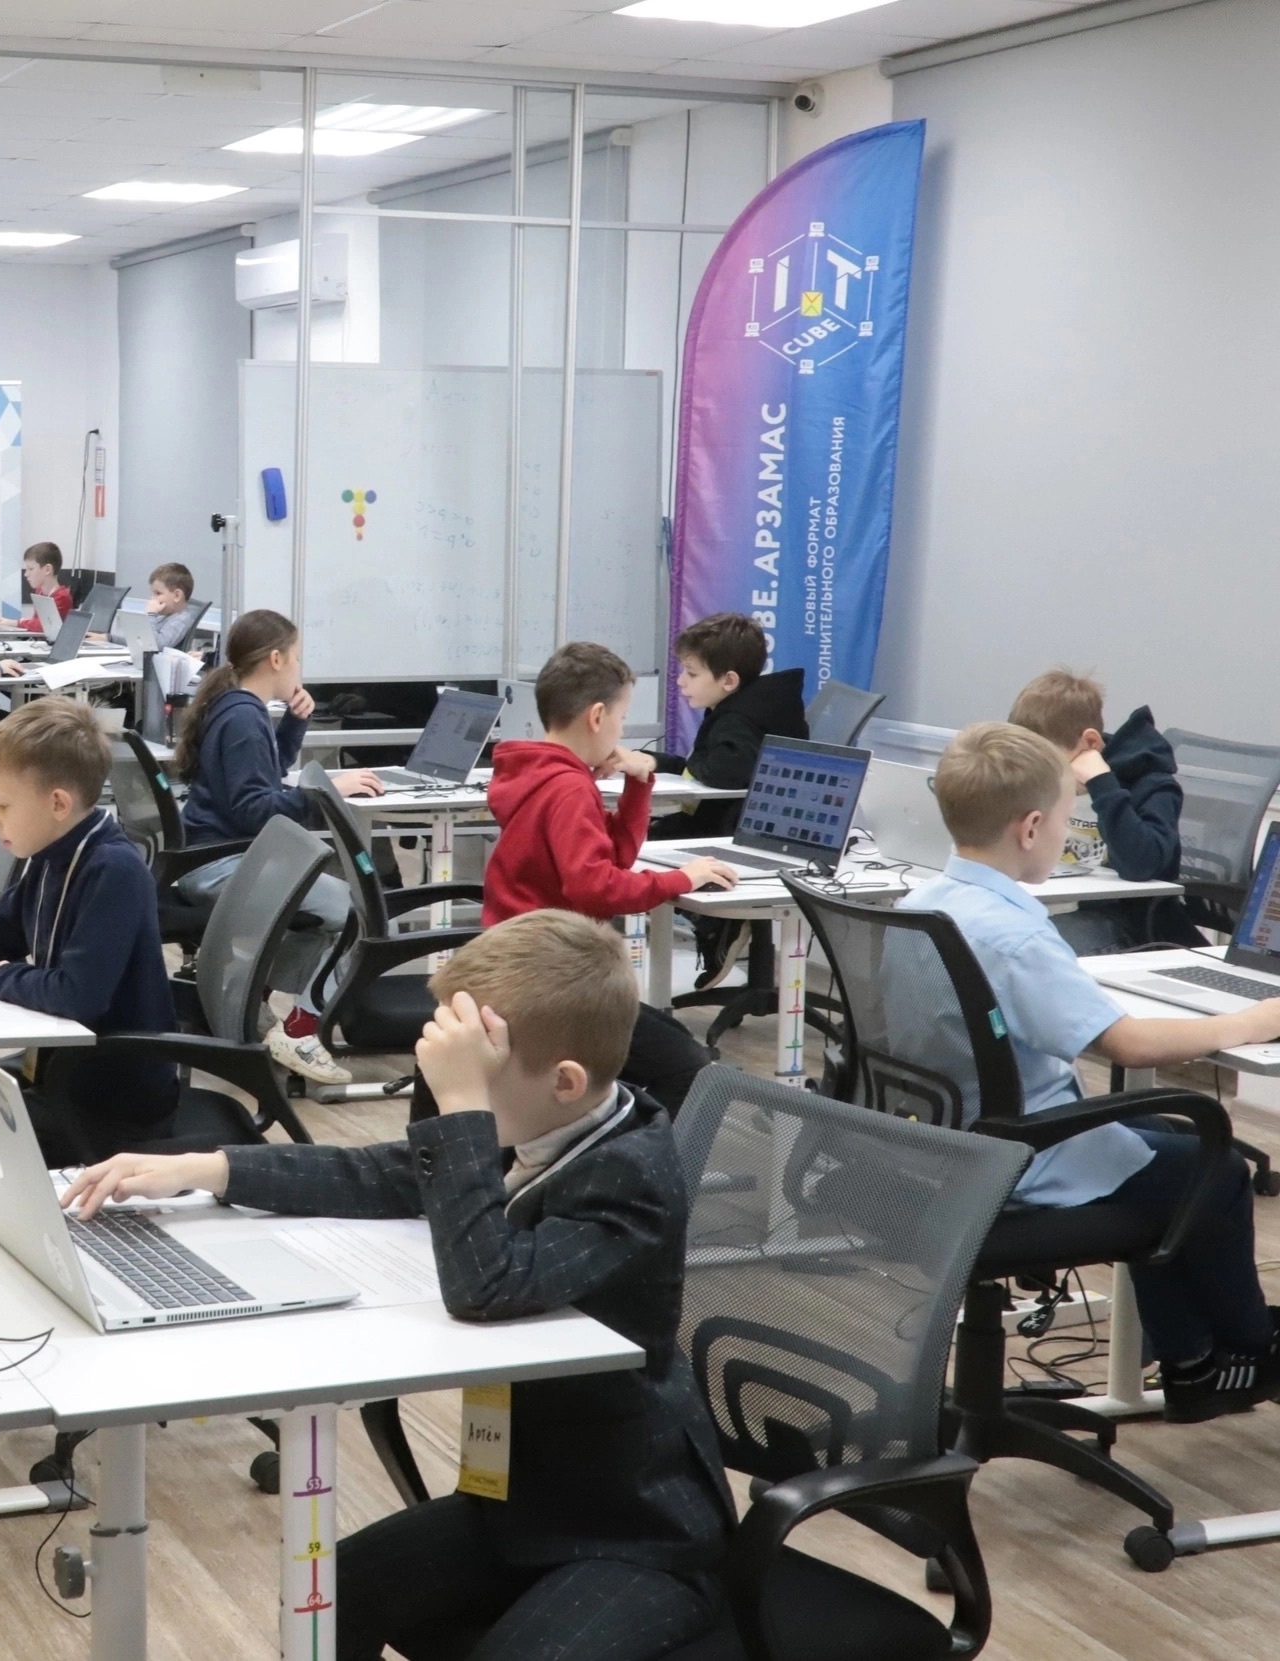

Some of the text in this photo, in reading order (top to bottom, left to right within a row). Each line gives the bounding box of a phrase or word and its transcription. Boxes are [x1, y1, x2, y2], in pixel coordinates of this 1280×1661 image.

[782, 318, 841, 355] CUBE
[824, 416, 846, 539] ОБРАЗОВАНИЯ
[804, 496, 822, 636] НОВЫЙ ФОРМАТ
[307, 1479, 320, 1490] 53
[308, 1541, 321, 1554] 59
[309, 1595, 322, 1606] 64
